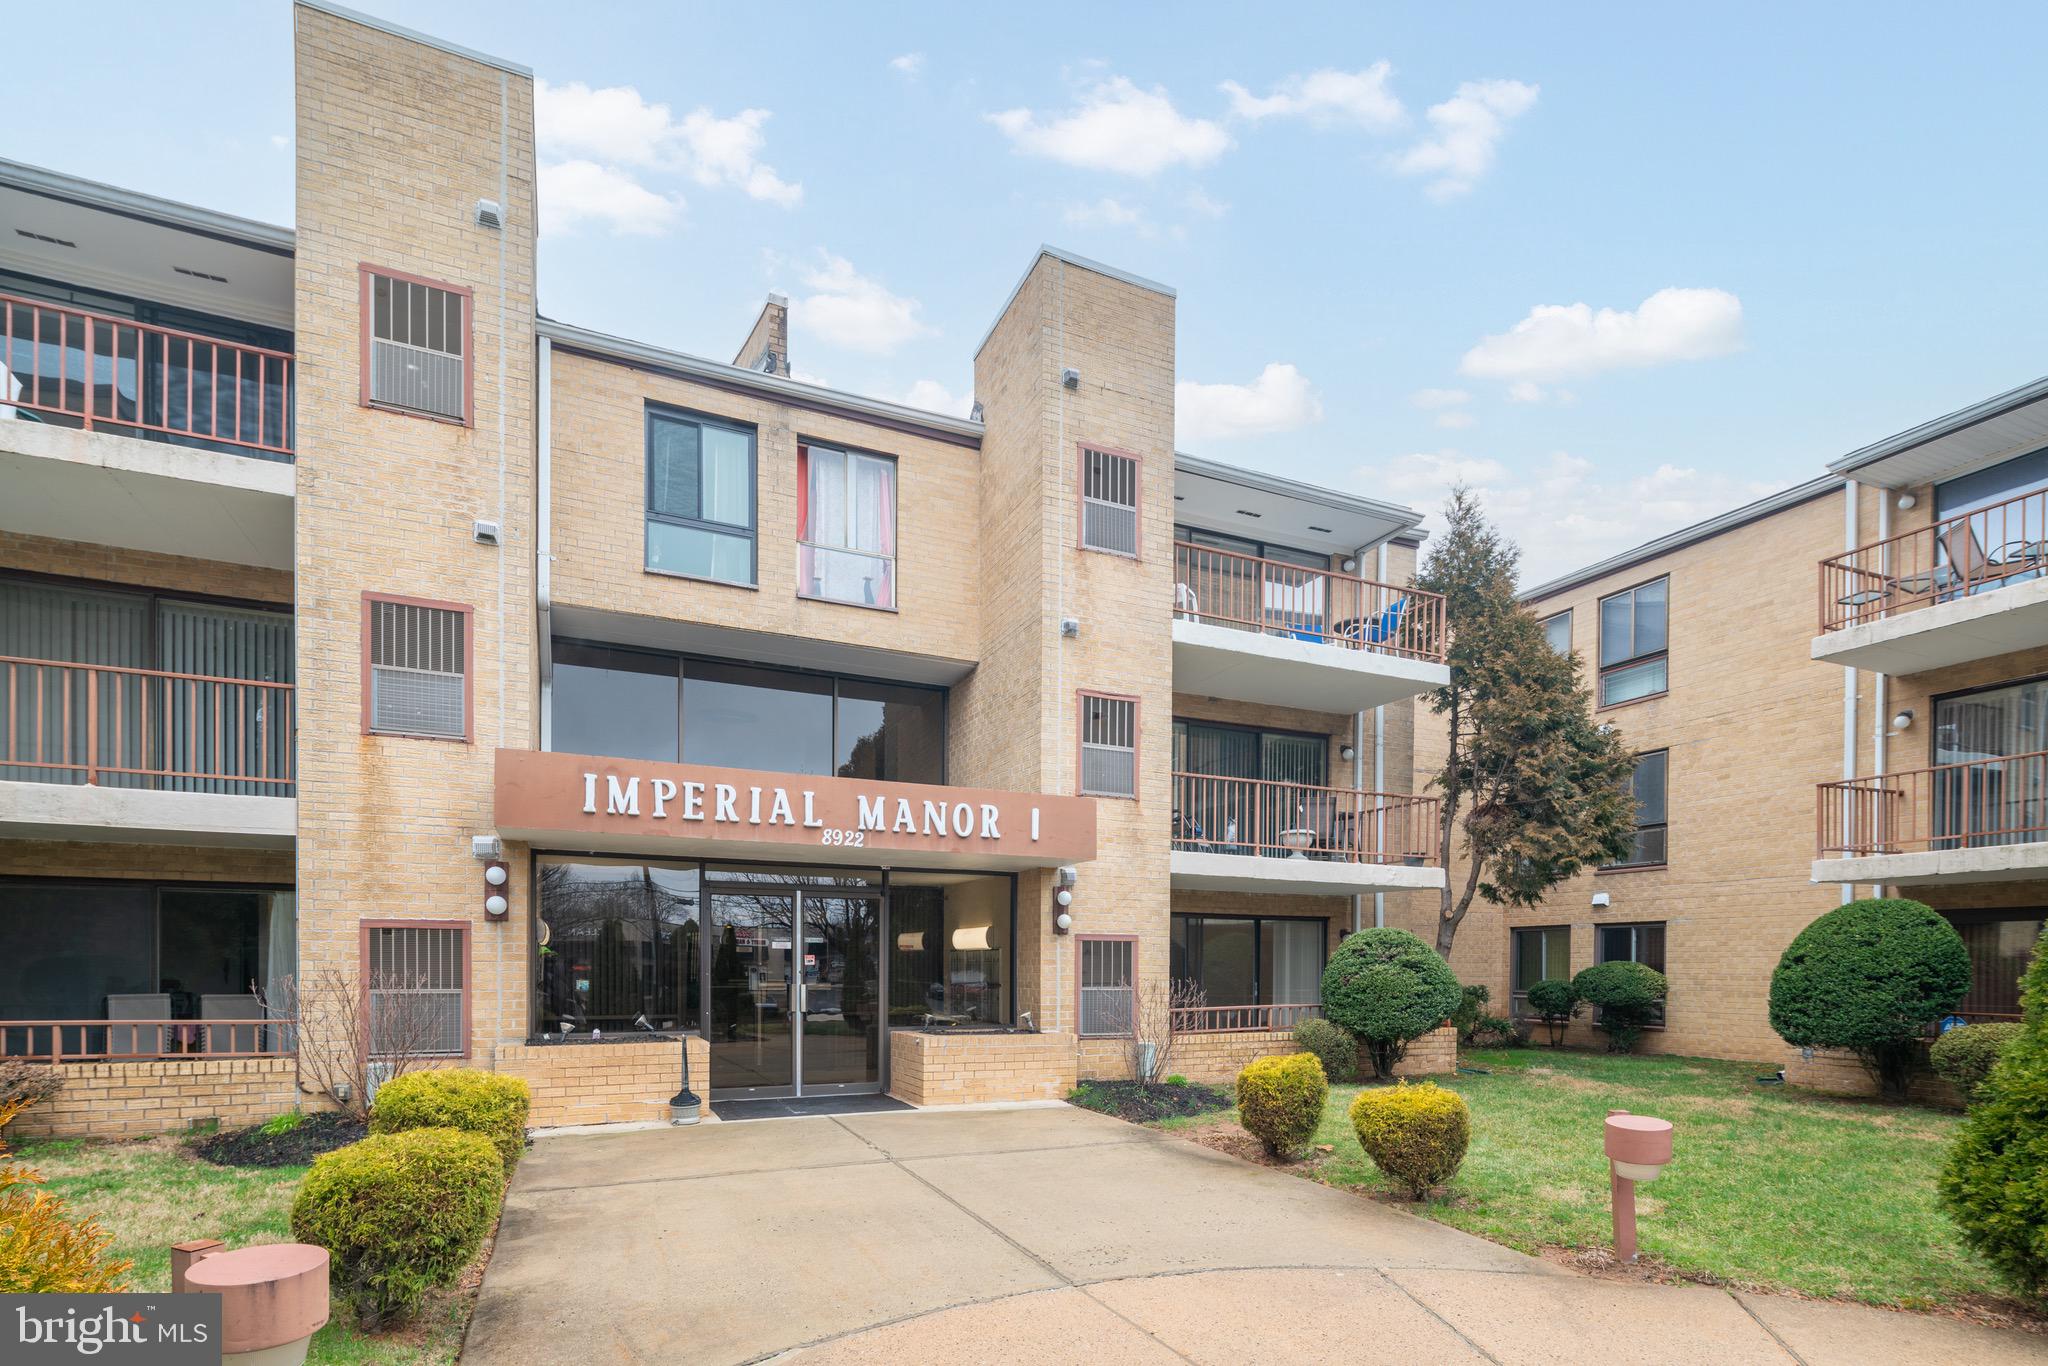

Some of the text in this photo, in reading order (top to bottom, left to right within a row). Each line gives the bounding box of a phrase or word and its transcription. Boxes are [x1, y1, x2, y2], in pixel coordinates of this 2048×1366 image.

[583, 773, 1040, 841] IMPERIAL MANOR I
[821, 829, 864, 847] 8922
